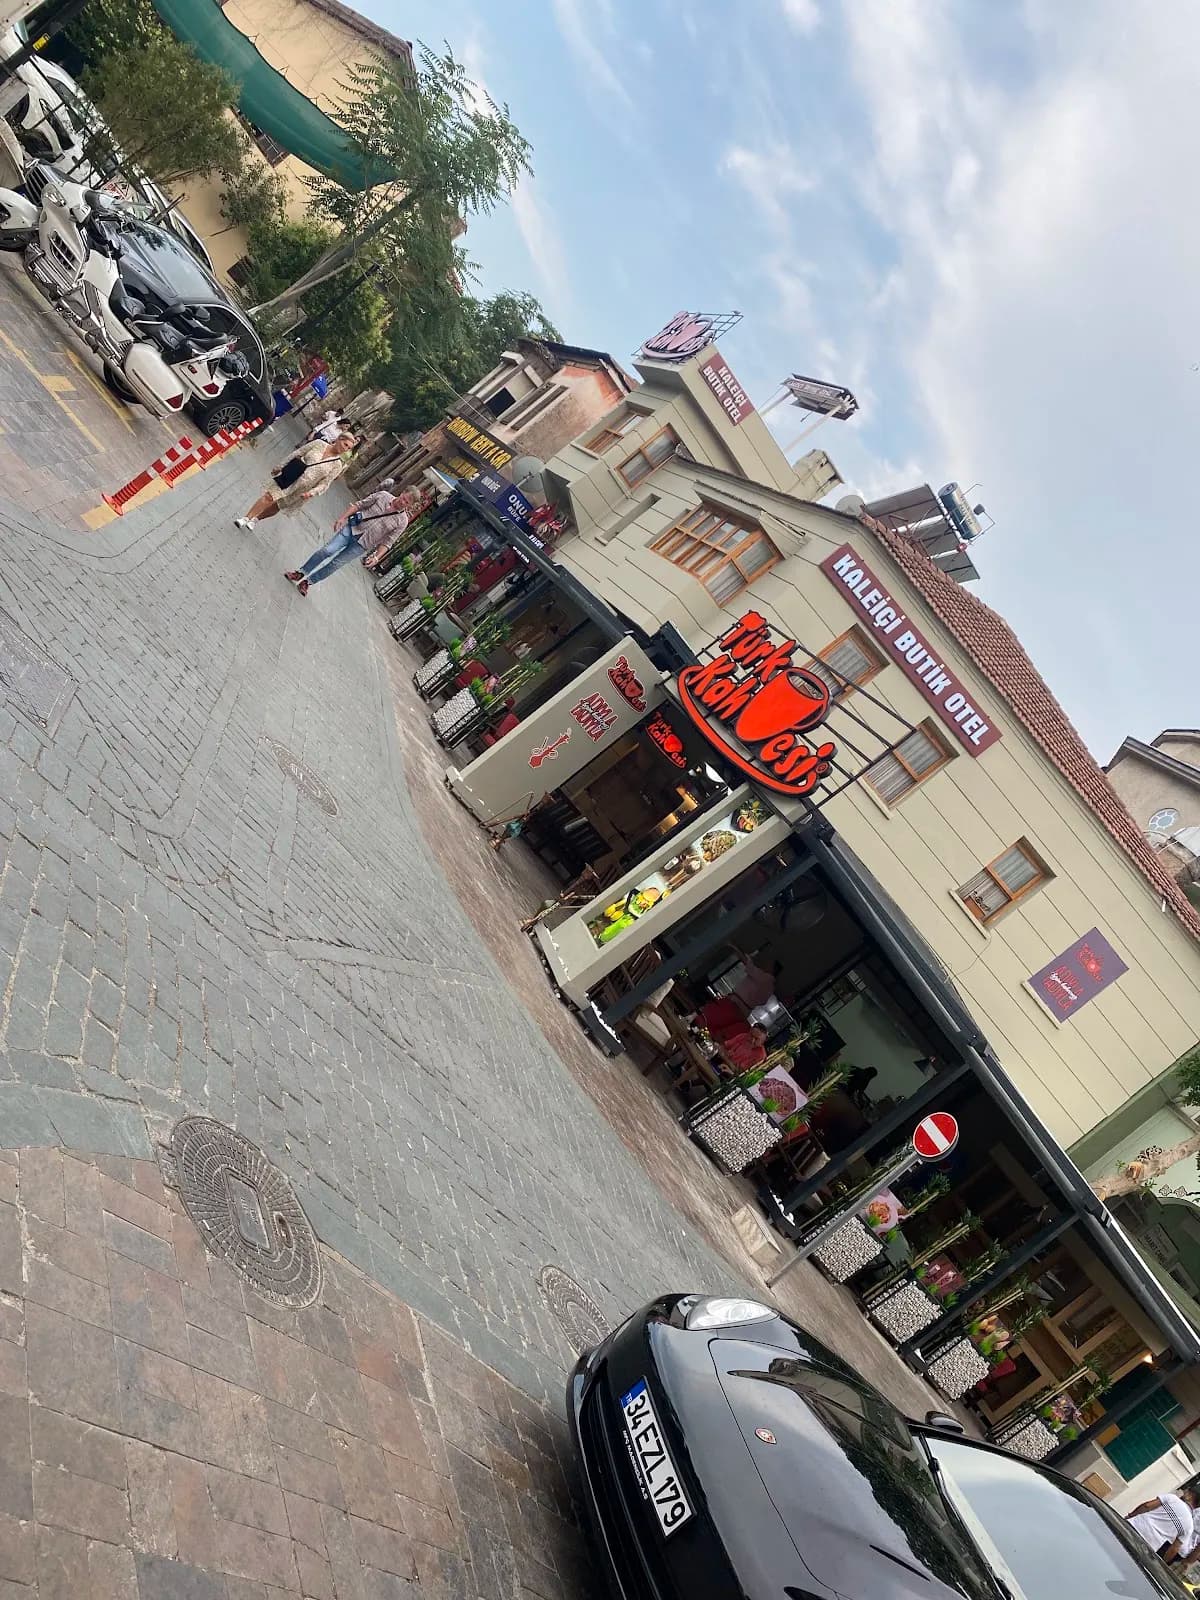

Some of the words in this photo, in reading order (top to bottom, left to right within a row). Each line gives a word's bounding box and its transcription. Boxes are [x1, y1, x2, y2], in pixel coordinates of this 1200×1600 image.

[702, 365, 727, 397] BUTİK
[723, 397, 742, 423] OTEL
[718, 366, 747, 407] KALEİÇİ
[470, 434, 495, 455] RENT
[490, 450, 512, 469] CAR
[508, 494, 528, 519] ONU
[719, 611, 797, 682] Türk
[832, 552, 906, 634] KALEİÇİ
[893, 629, 951, 696] BUTİK
[943, 692, 992, 747] OTEL
[627, 1394, 650, 1431] 34
[634, 1421, 667, 1485] EZL
[653, 1476, 686, 1528] 179
